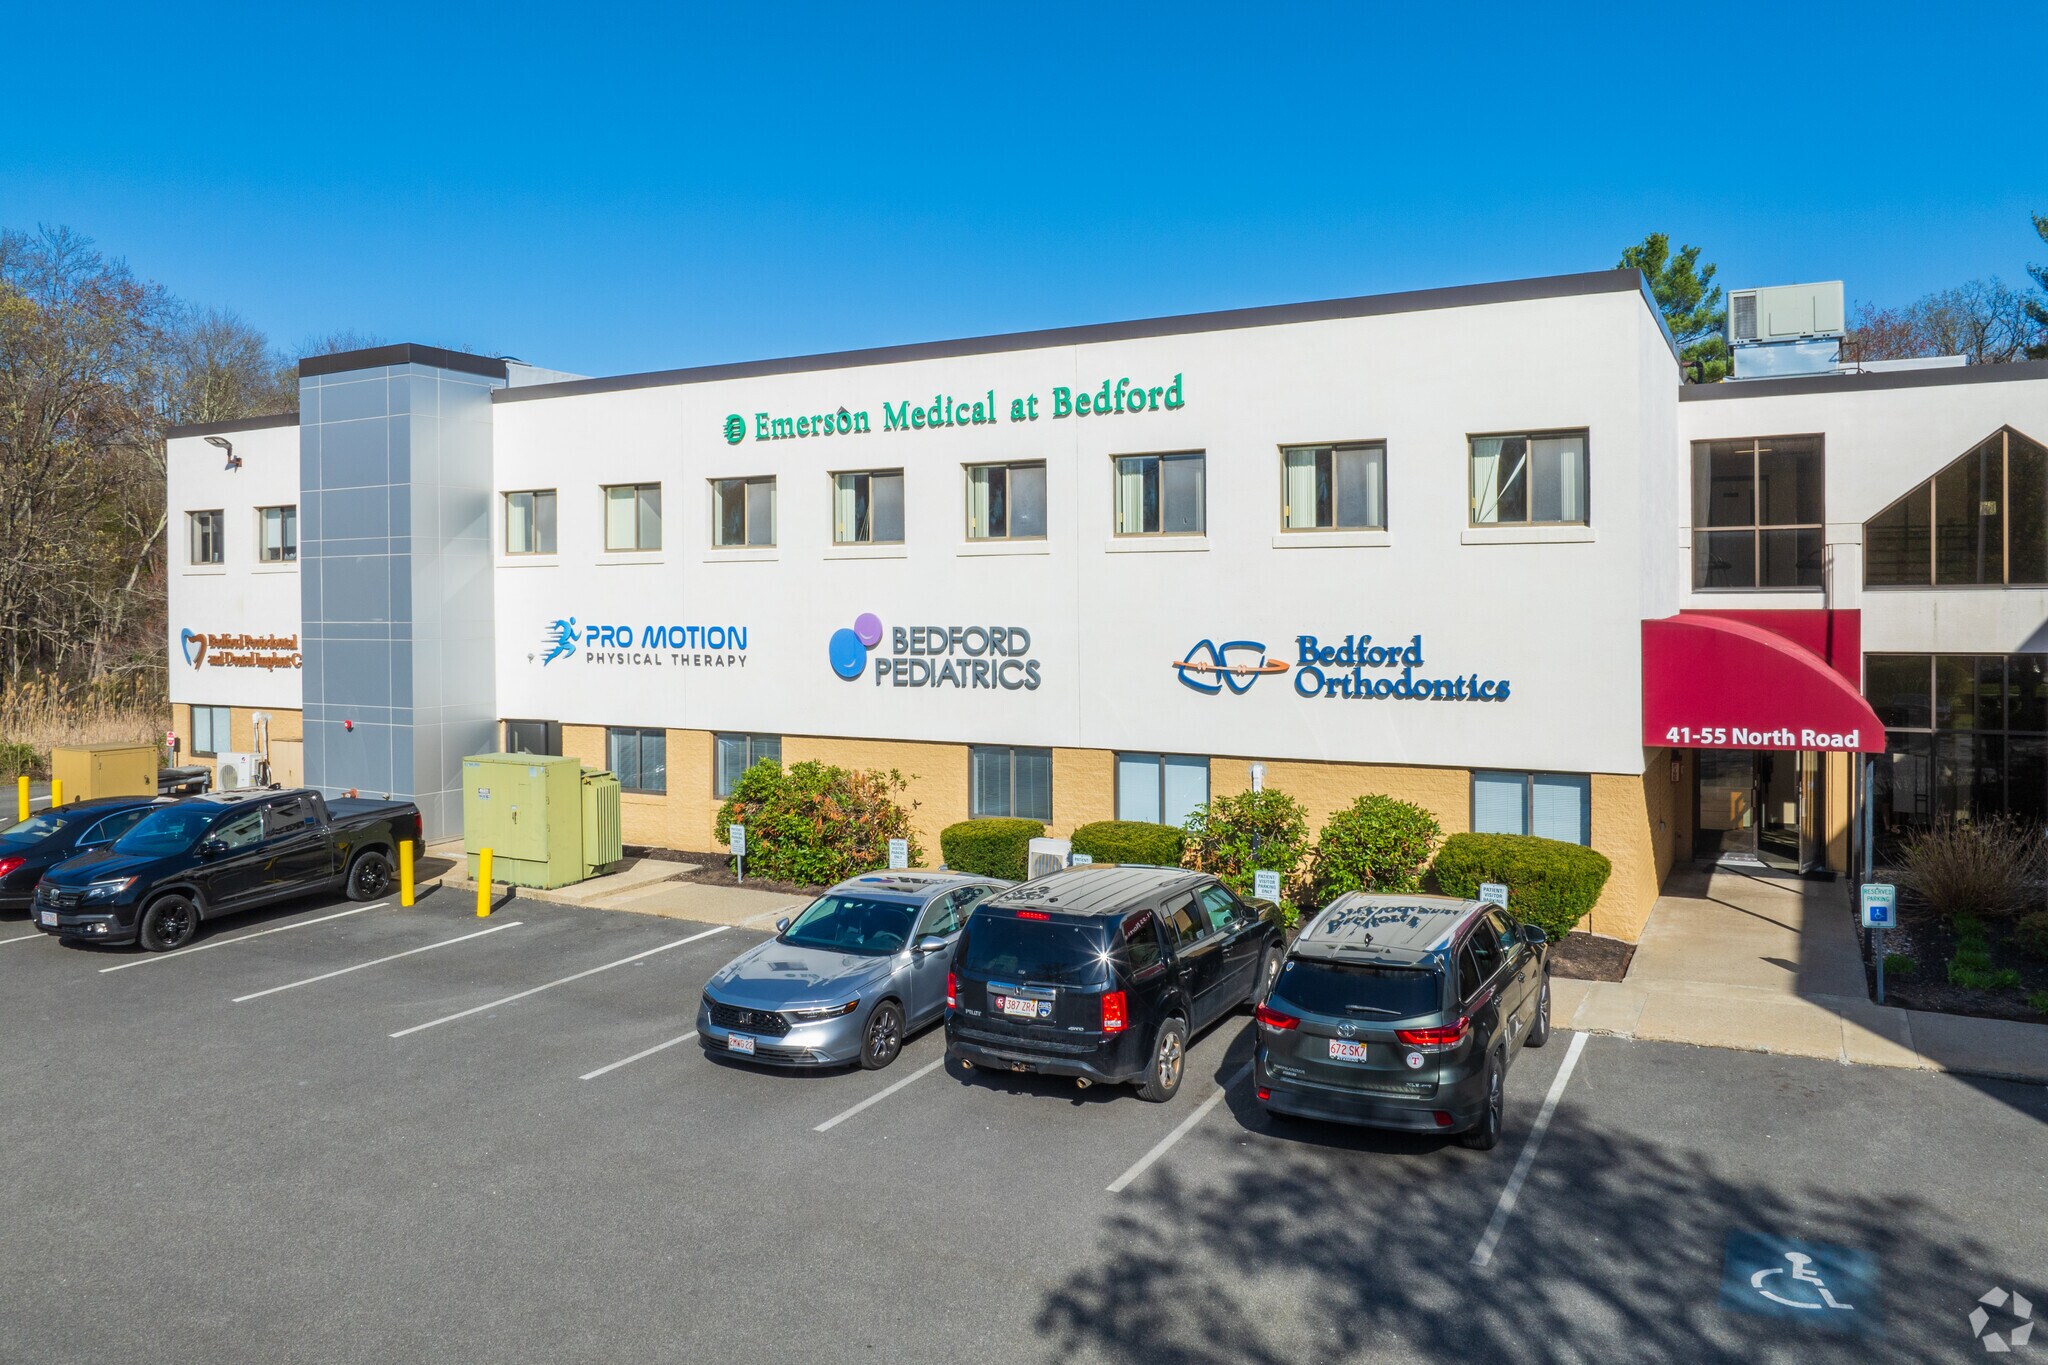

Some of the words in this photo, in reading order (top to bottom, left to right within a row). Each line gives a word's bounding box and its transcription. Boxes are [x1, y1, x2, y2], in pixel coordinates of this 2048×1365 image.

[755, 410, 870, 439] Emerson
[883, 390, 996, 430] Medical
[1010, 394, 1038, 421] at
[1053, 373, 1184, 418] Bedford
[208, 634, 244, 649] Bedford
[586, 625, 633, 648] PRO
[641, 625, 747, 650] MOTION
[892, 626, 1031, 656] BEDFORD
[207, 651, 224, 666] and
[225, 652, 254, 667] Dental
[586, 653, 662, 666] PHYSICAL
[672, 653, 747, 667] THERAPY
[1296, 634, 1424, 667] Bedford
[875, 658, 1042, 690] PEDIATRICS
[1295, 665, 1511, 701] Orthodontics
[1666, 727, 1726, 744] 41-55
[1732, 728, 1795, 746] North
[1801, 730, 1859, 748] Road
[1006, 999, 1020, 1010] 387
[1022, 1001, 1035, 1012] ZR4
[1330, 1043, 1347, 1055] 672
[1349, 1044, 1366, 1057] SK7
